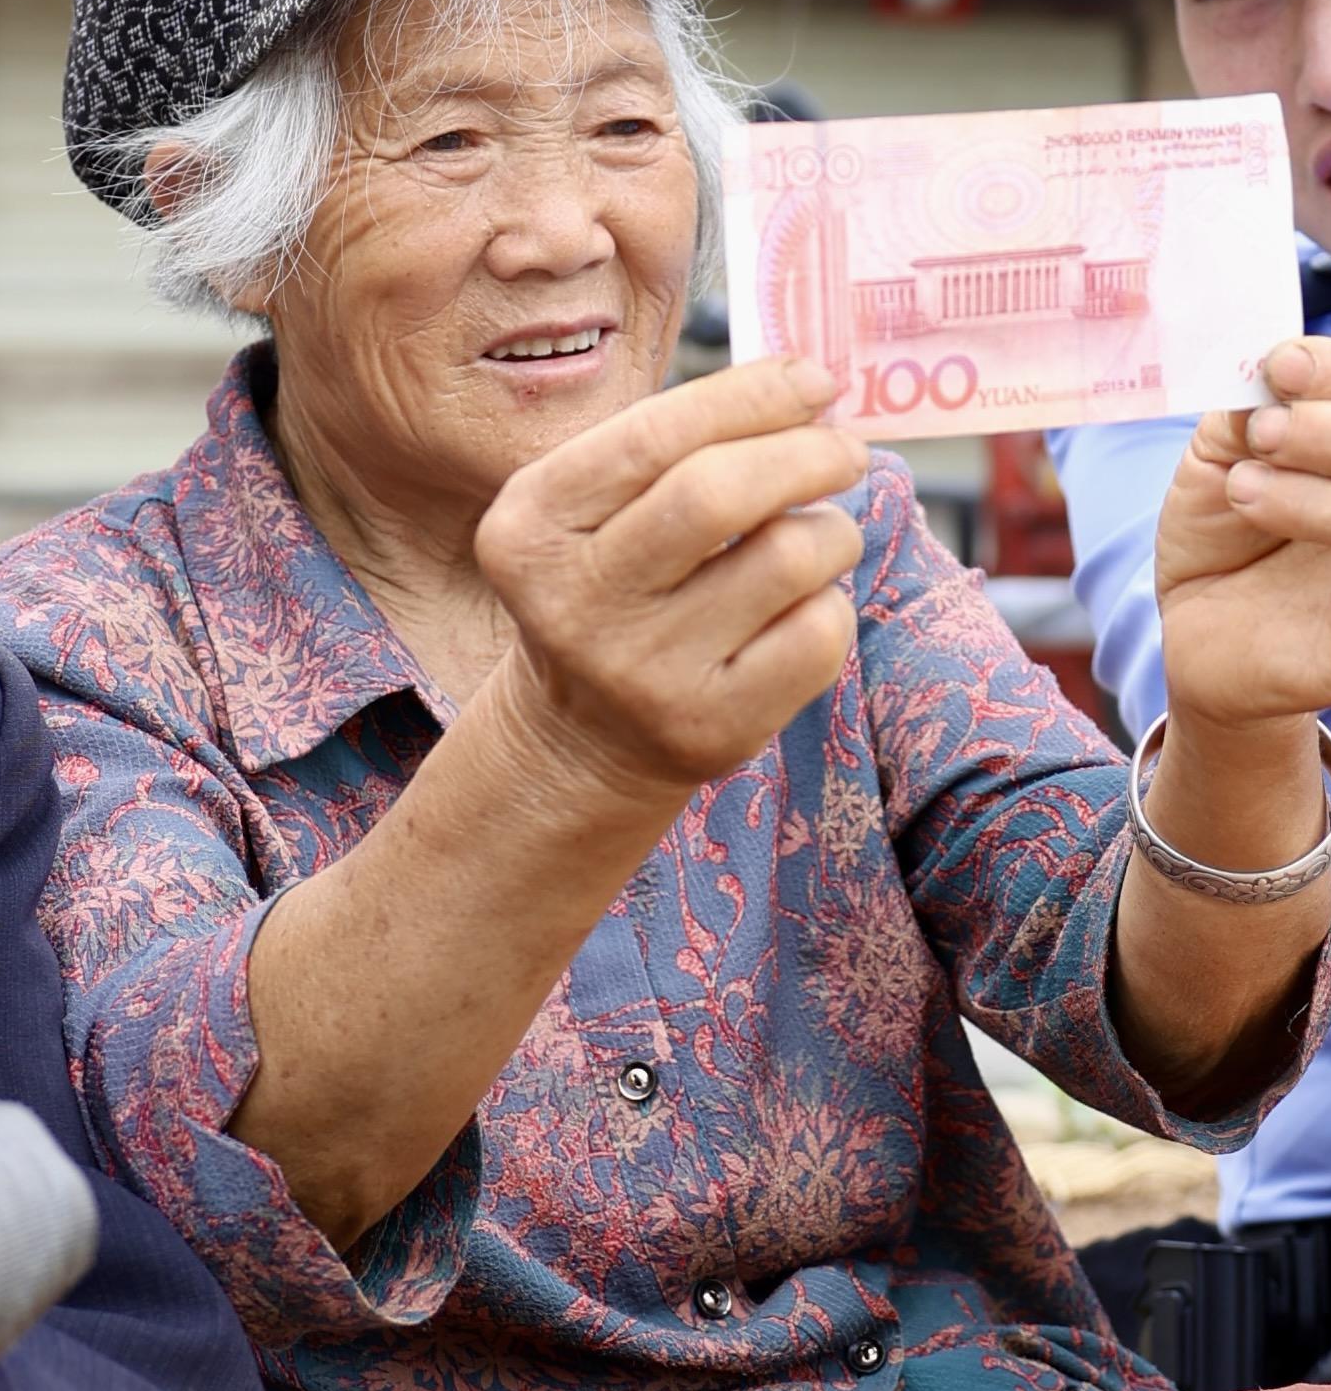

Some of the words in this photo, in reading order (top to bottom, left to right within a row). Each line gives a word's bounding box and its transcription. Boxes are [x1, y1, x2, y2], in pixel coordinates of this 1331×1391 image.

[764, 143, 862, 190] 100
[853, 354, 978, 418] 100
[977, 384, 1040, 409] YUAN
